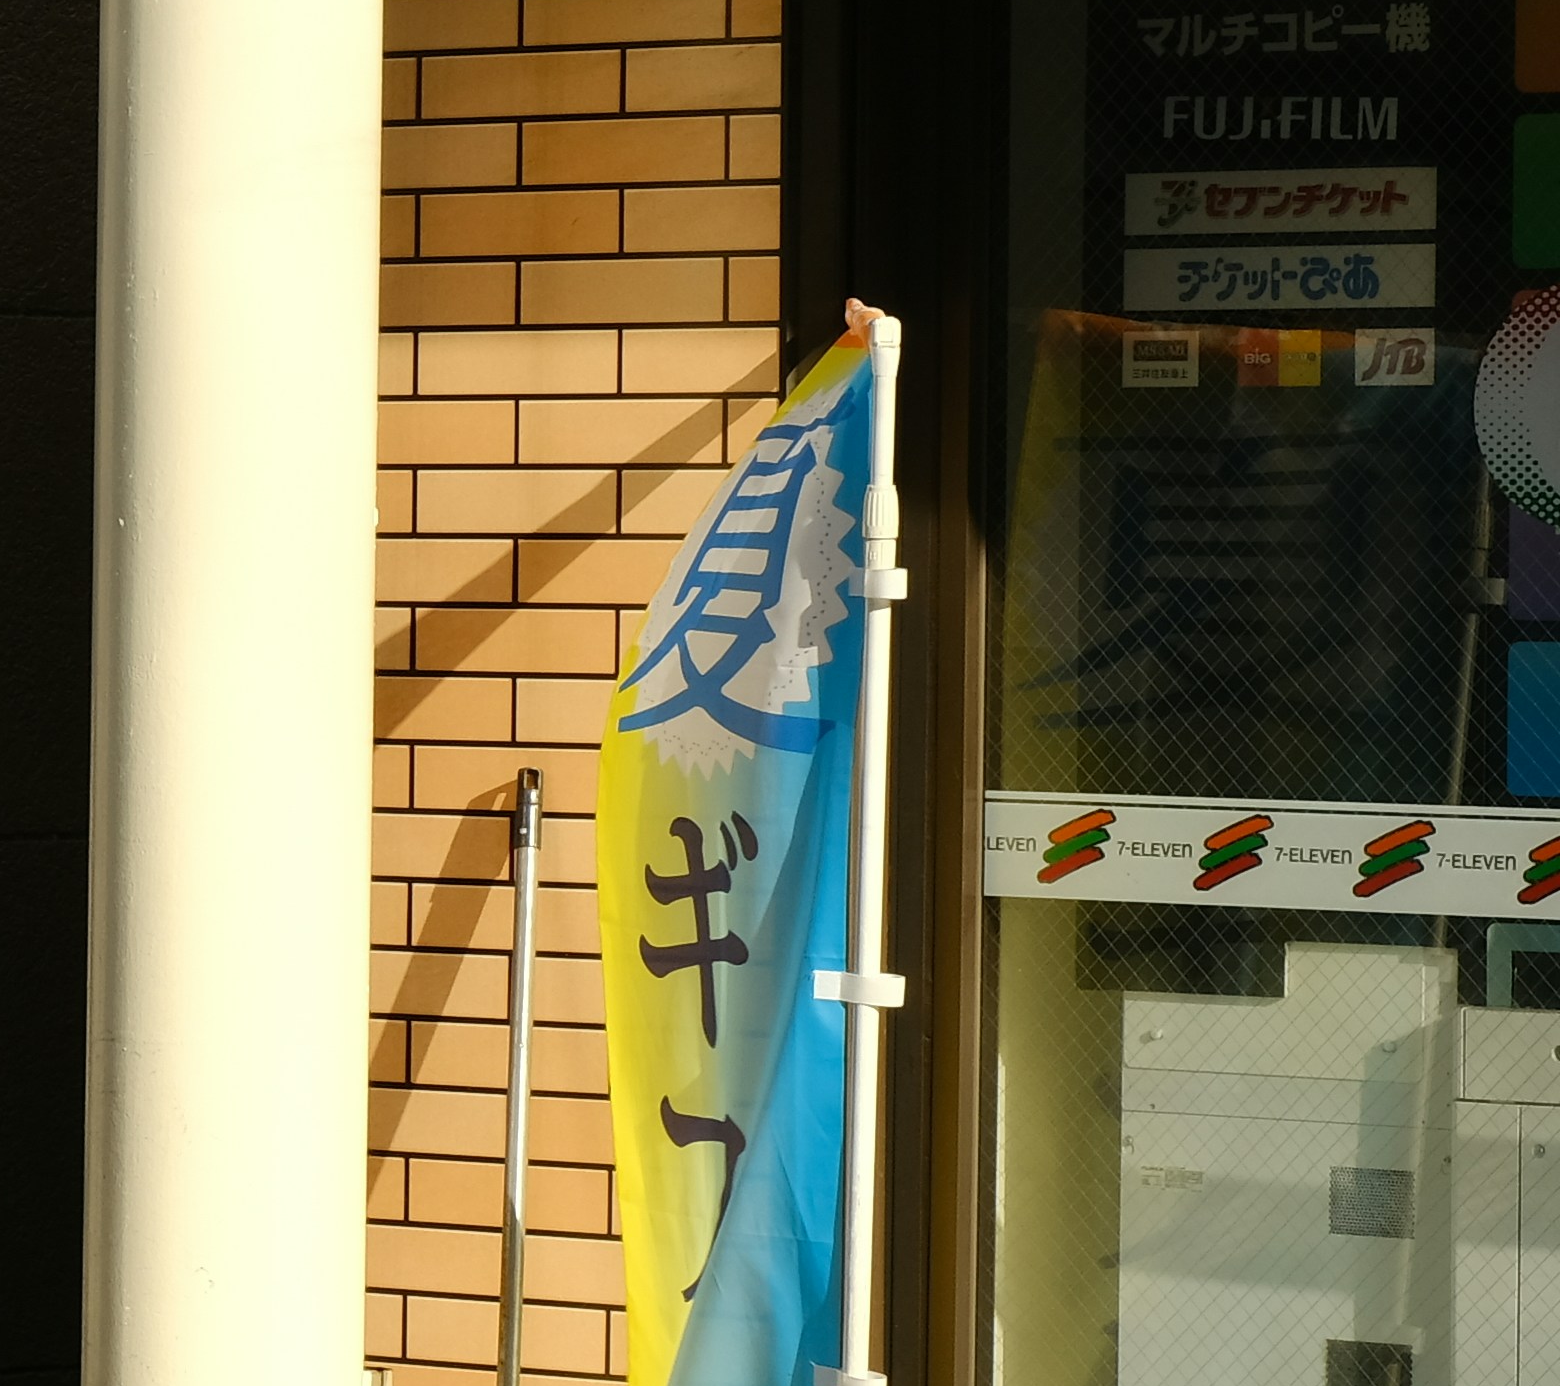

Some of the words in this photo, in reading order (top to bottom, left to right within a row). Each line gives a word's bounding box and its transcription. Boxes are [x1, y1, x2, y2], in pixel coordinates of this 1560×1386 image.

[1137, 3, 1431, 57] マルチコピー機
[1162, 96, 1399, 140] FUJIFILM
[1204, 179, 1410, 218] セブンチケット
[1177, 253, 1380, 302] チケットぴあ
[1361, 337, 1427, 381] JTB
[1116, 840, 1193, 860] 7-ELEVEN
[1274, 846, 1352, 867] 7-ELEVEN
[1436, 852, 1517, 872] 7-ELEVEN
